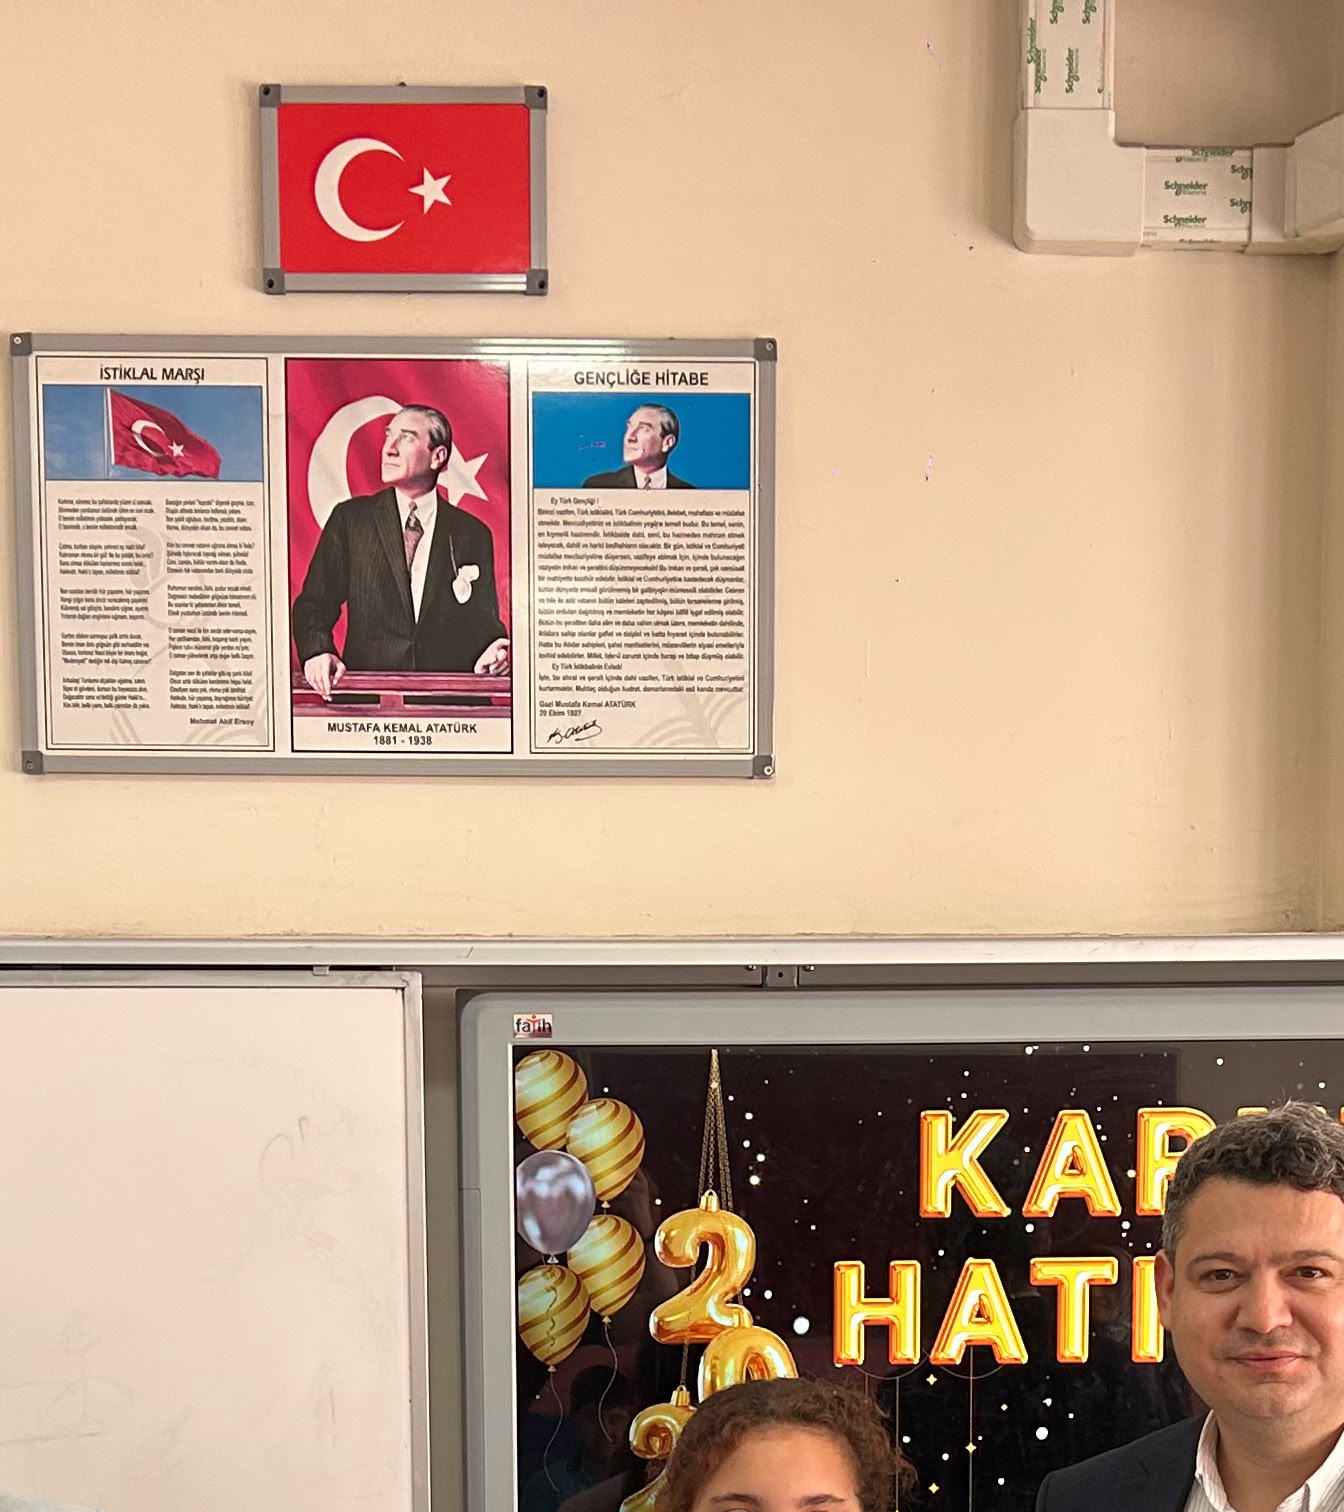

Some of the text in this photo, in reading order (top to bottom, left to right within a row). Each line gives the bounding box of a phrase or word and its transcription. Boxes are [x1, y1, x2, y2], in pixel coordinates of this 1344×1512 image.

[1065, 48, 1080, 94] Schneider
[1164, 180, 1208, 196] Schneider
[1163, 214, 1207, 227] Schneider
[99, 364, 205, 384] İSTİKLAL MARŞI
[574, 369, 709, 389] GENÇLİĞE HİTABE
[328, 721, 477, 733] MUSTAFA KEMAL ATATÜRK
[374, 736, 397, 745] 1881
[408, 736, 432, 746] 1938
[515, 1015, 553, 1033] fatih
